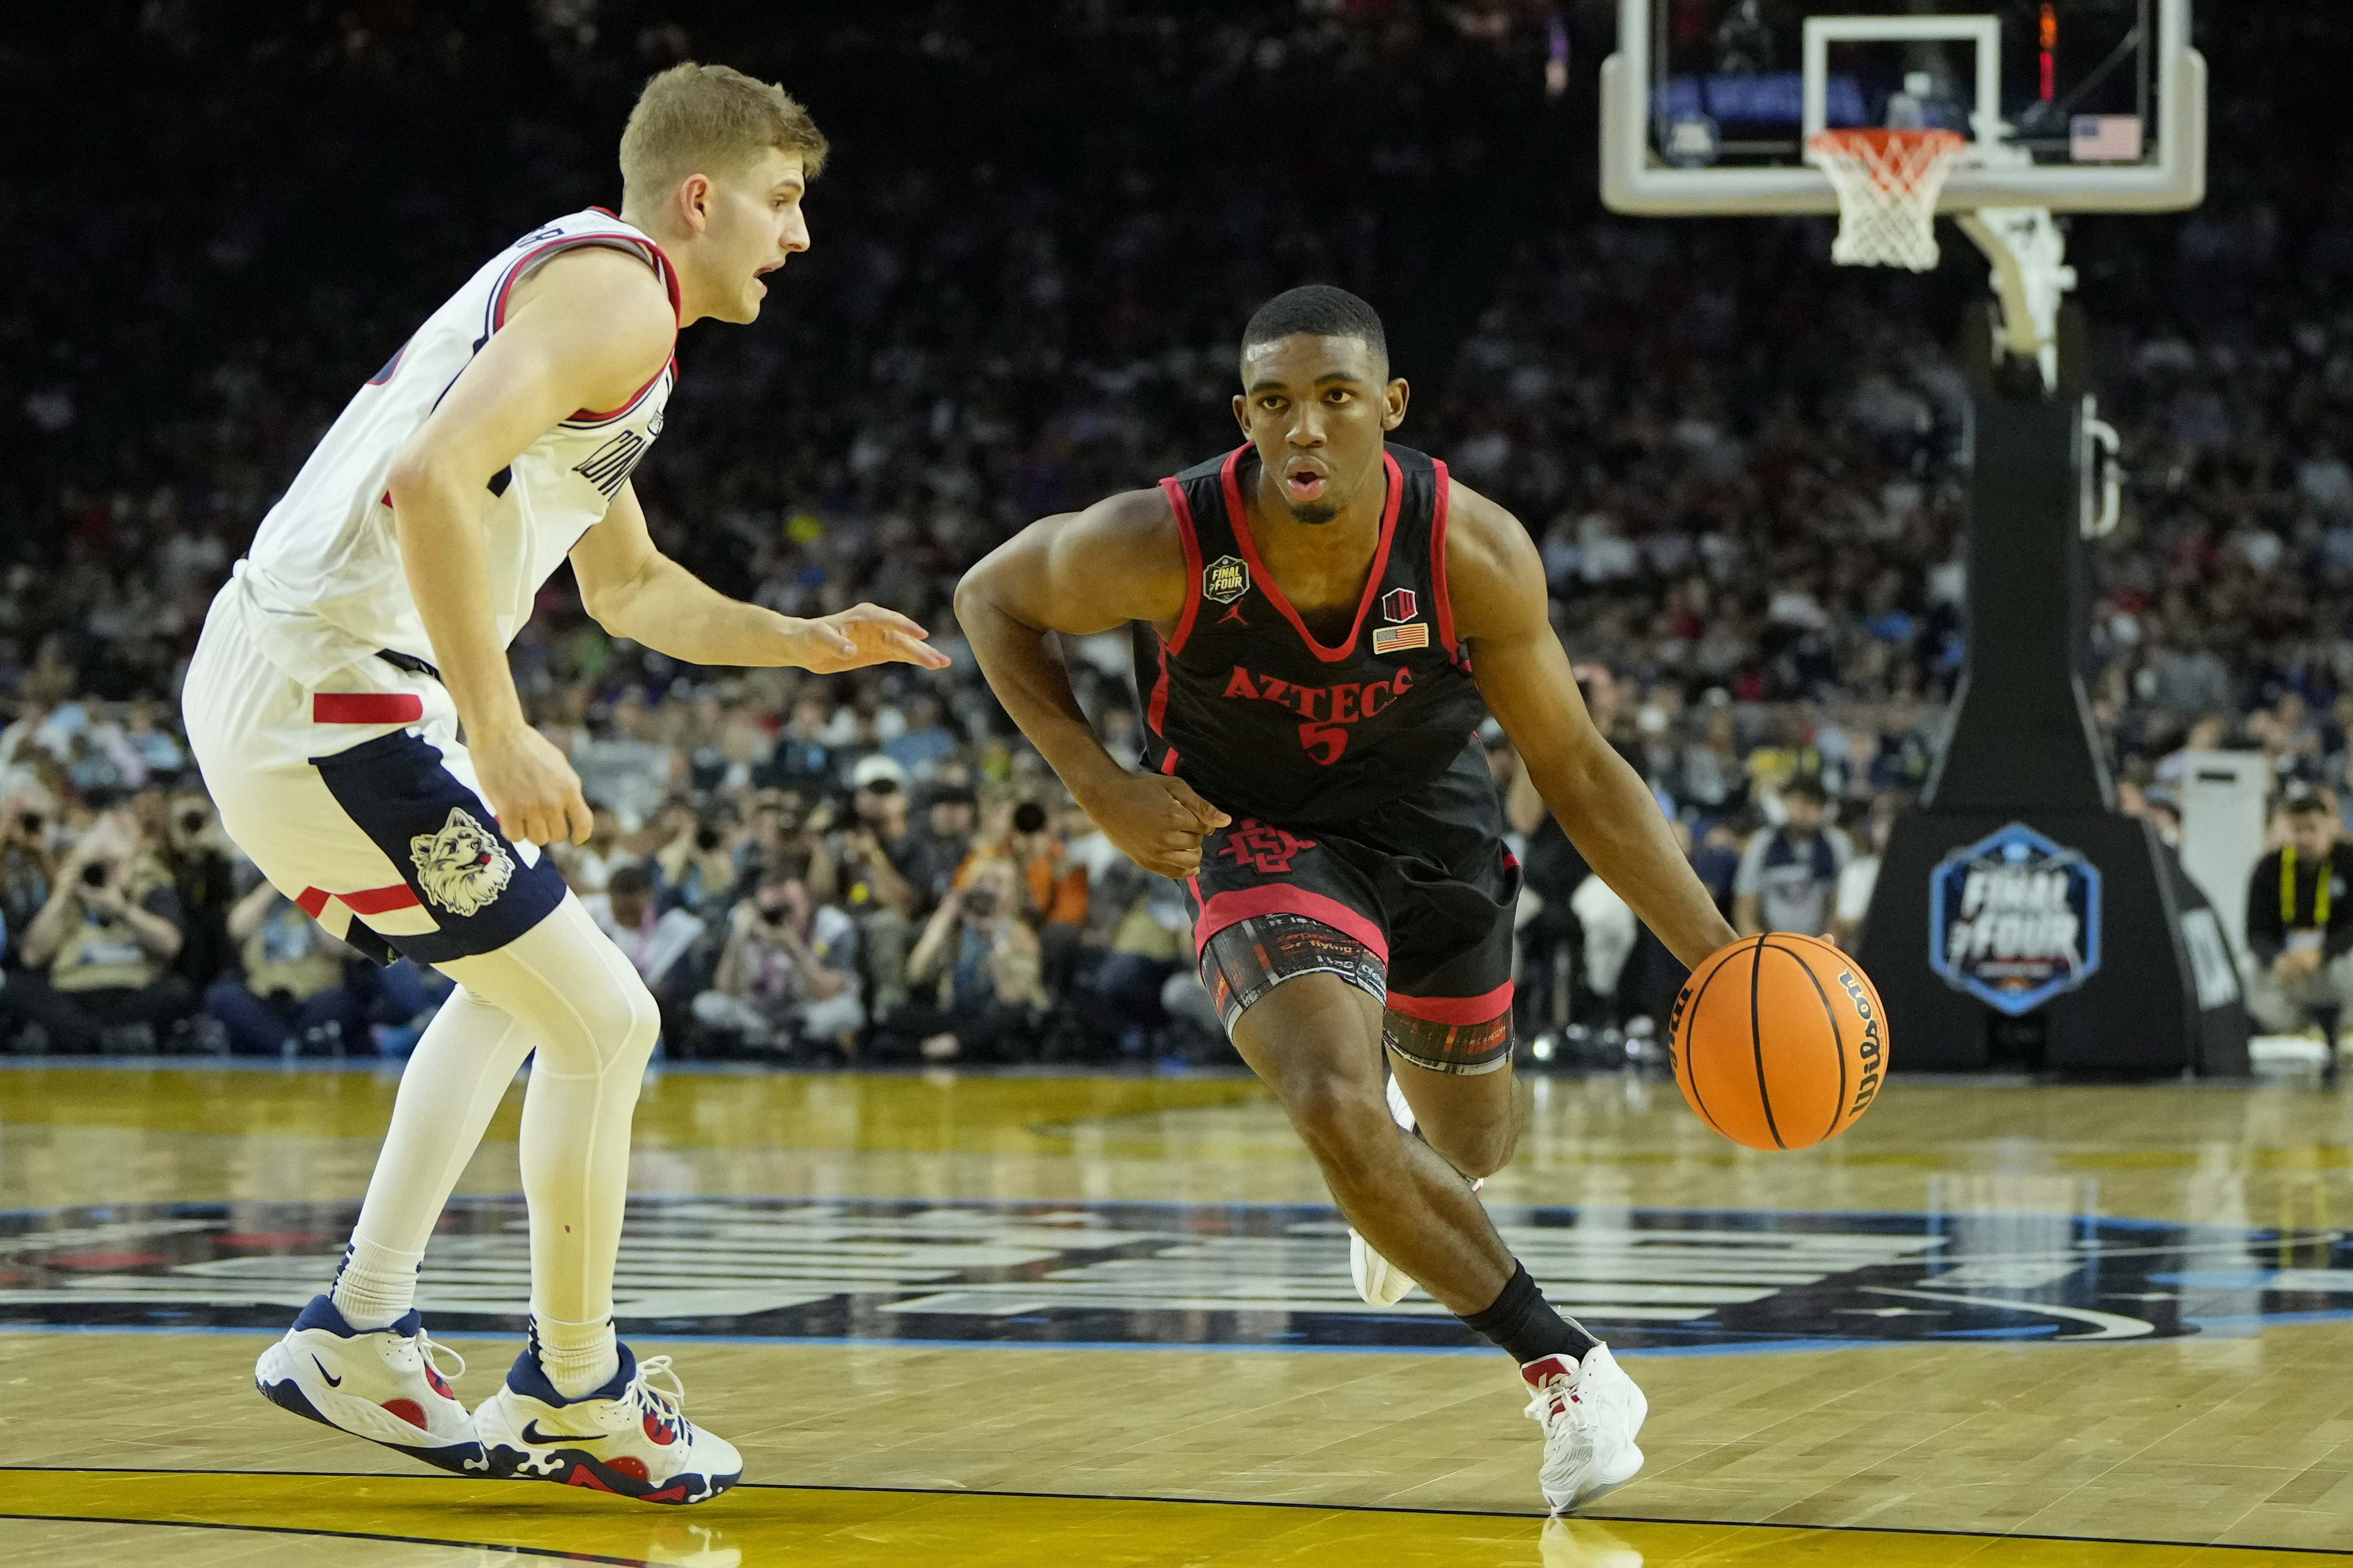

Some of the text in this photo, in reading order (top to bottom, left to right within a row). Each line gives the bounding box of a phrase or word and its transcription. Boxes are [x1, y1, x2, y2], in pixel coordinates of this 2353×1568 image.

[1212, 566, 1240, 581] FINAL
[1214, 576, 1242, 591] FOUR
[1299, 721, 1349, 766] 5
[1838, 970, 1881, 1117] Wilson
